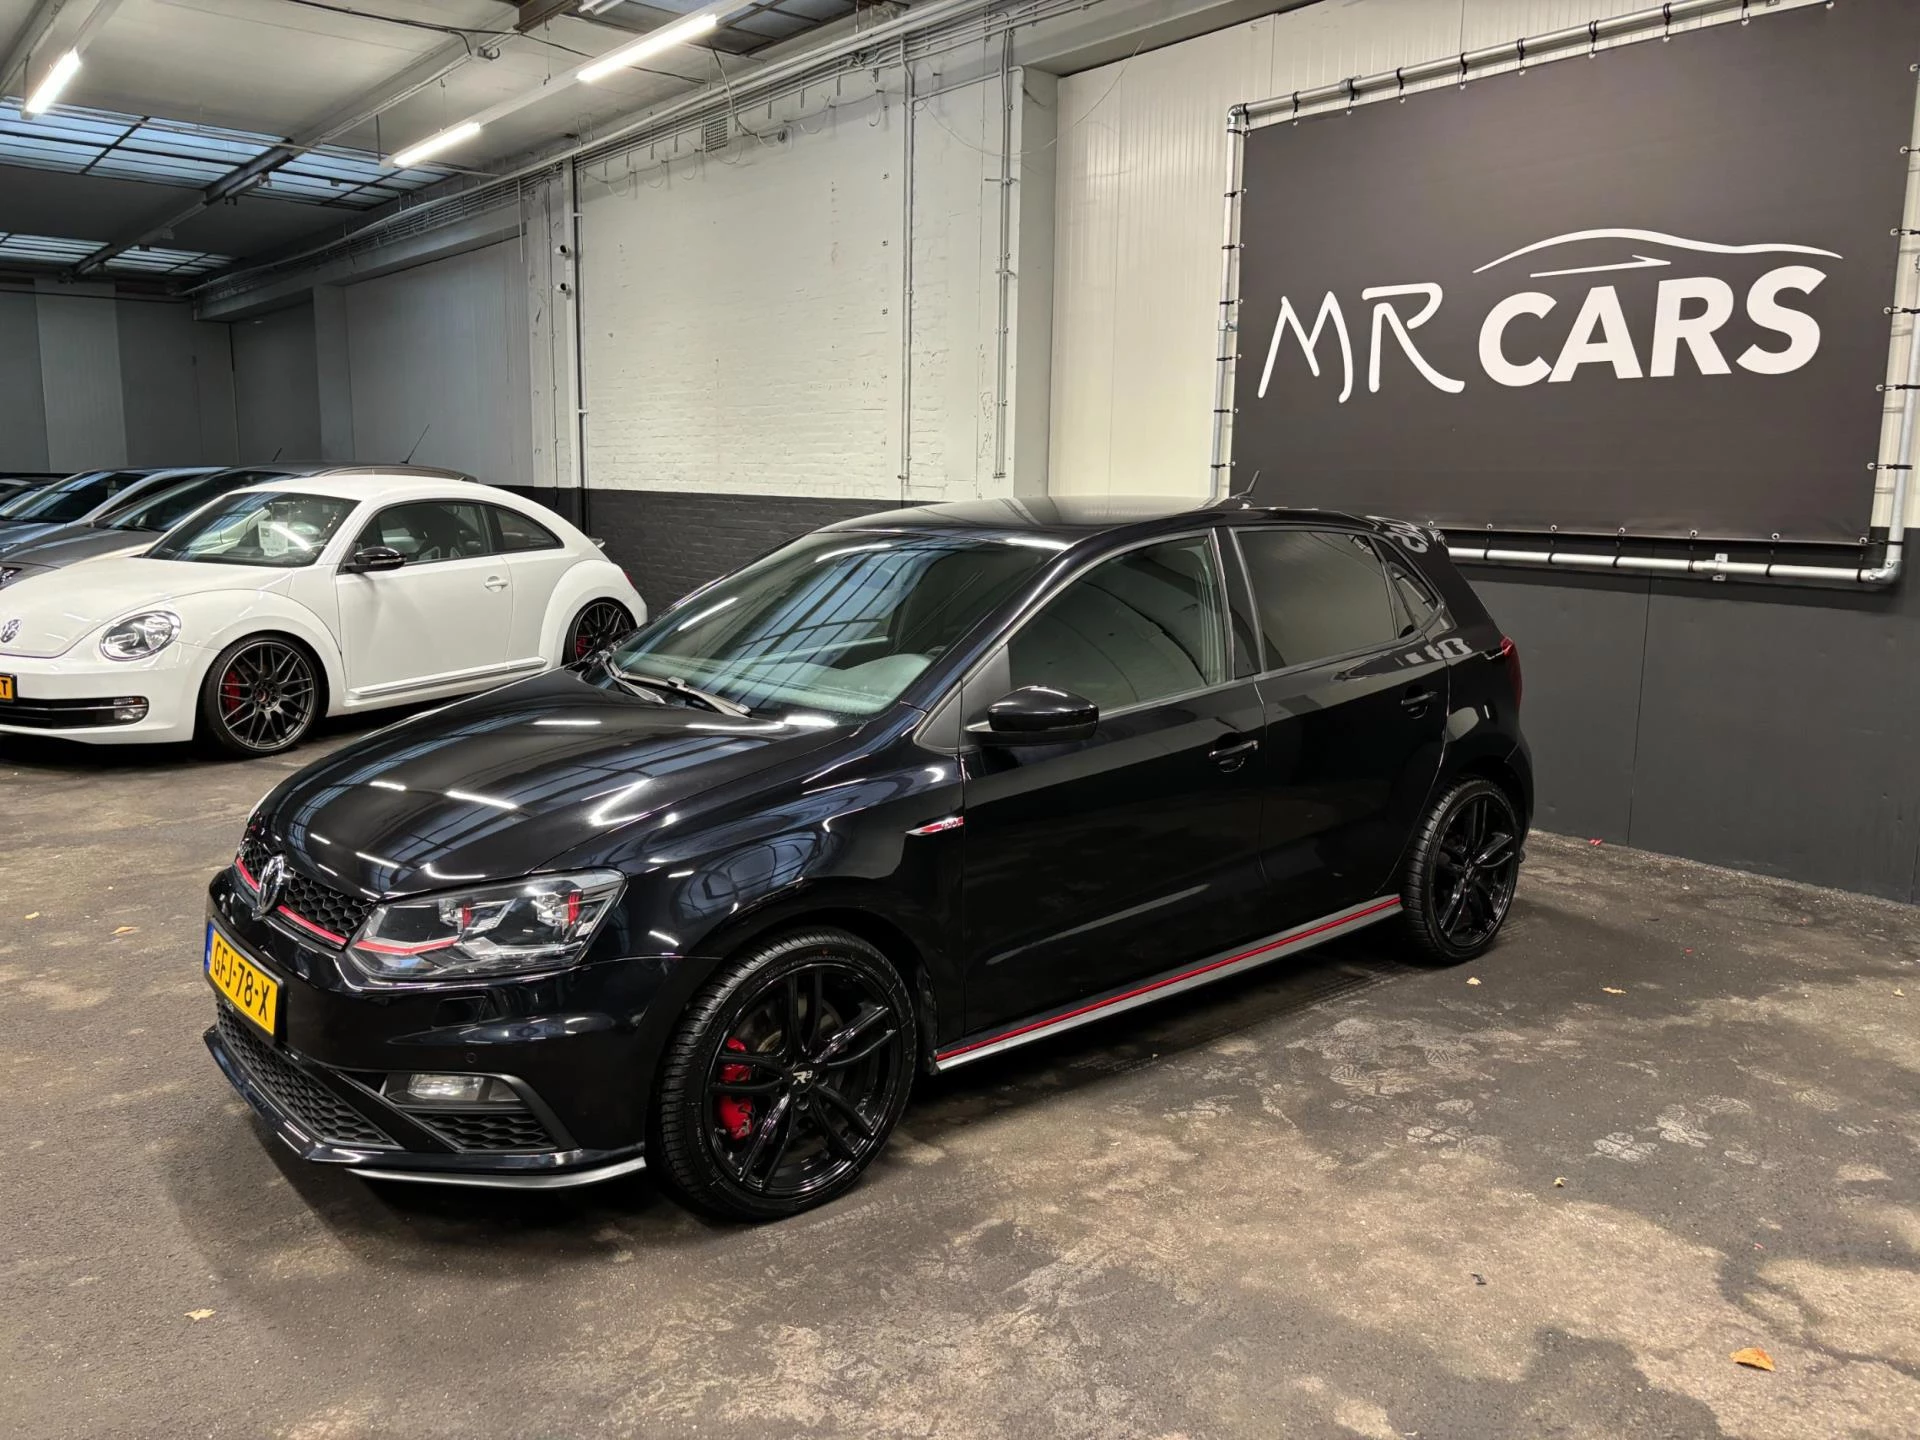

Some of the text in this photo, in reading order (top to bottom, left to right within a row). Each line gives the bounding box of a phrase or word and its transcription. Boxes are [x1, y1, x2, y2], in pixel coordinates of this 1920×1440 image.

[1258, 266, 1827, 403] MR CARS
[214, 940, 270, 1022] GFJ-78-X
